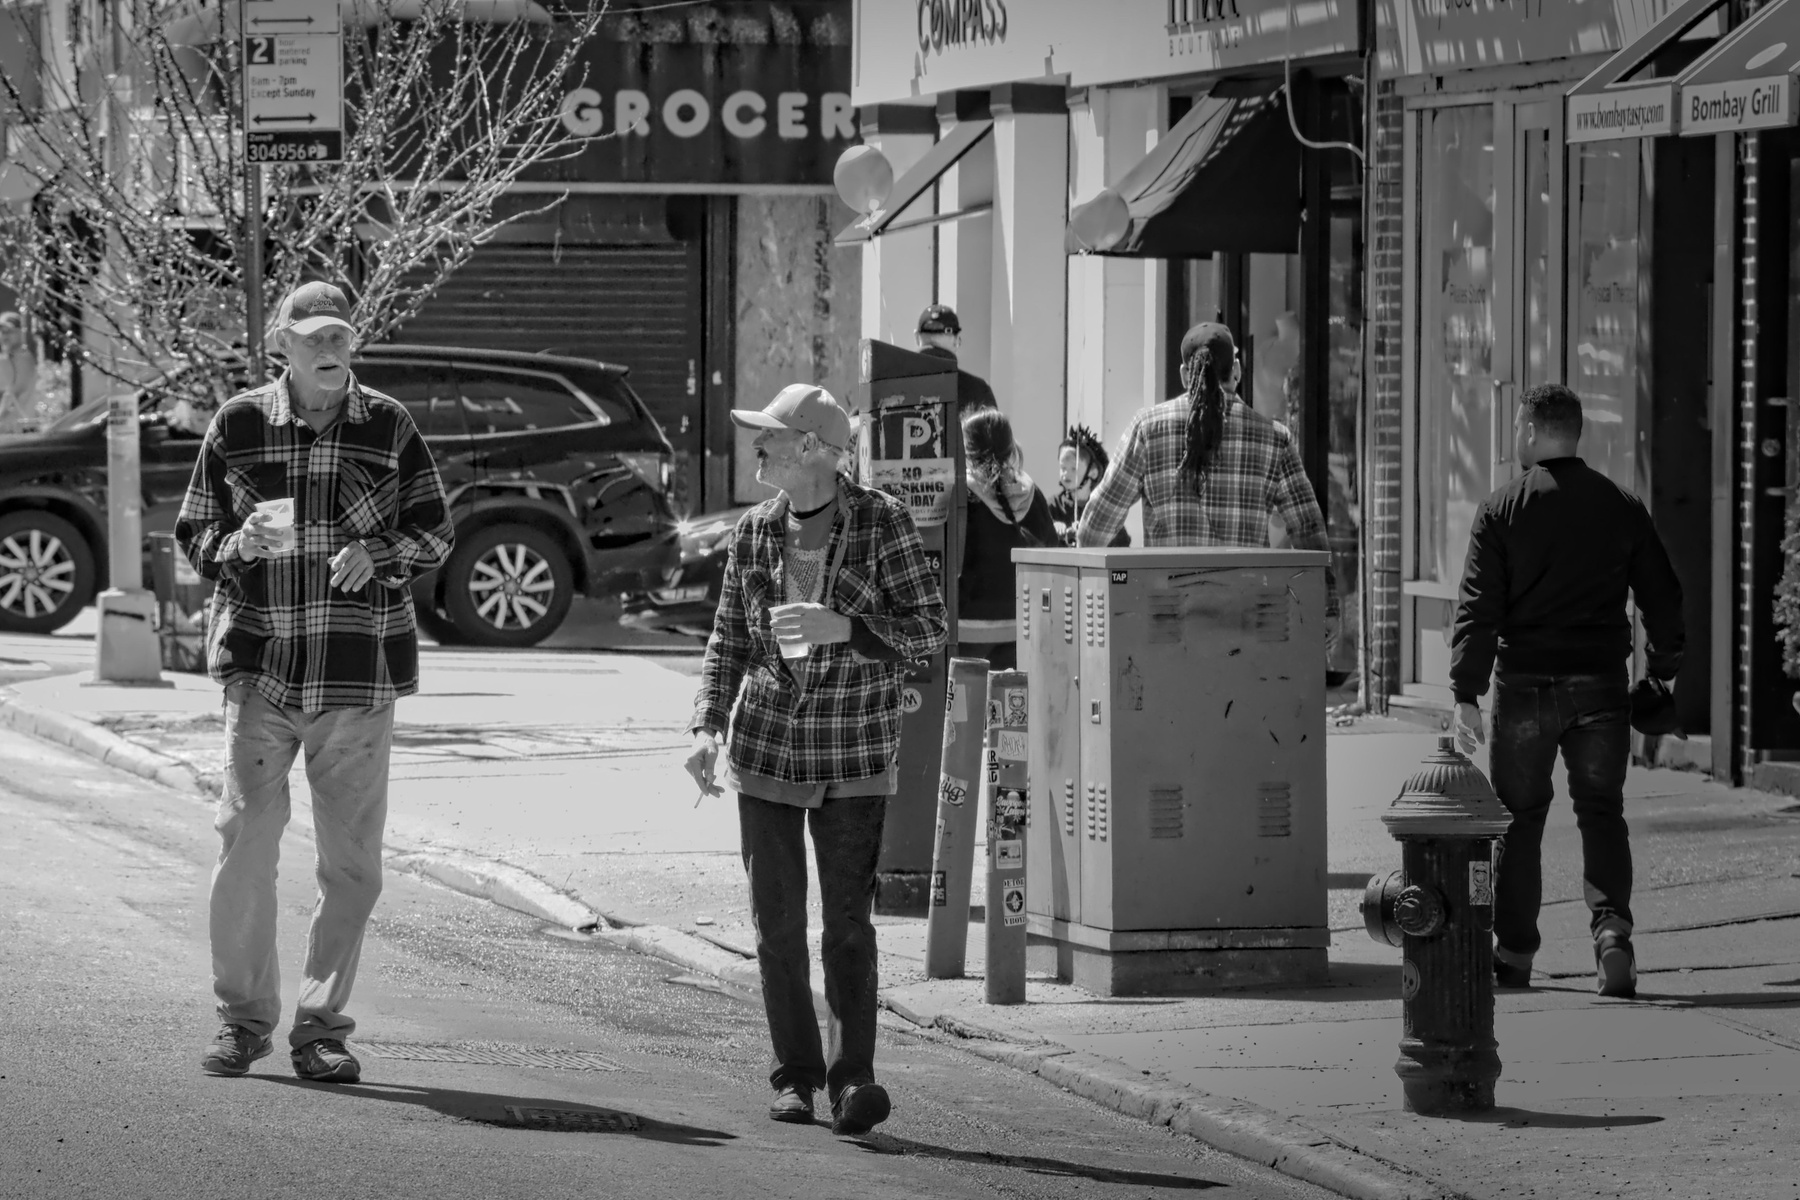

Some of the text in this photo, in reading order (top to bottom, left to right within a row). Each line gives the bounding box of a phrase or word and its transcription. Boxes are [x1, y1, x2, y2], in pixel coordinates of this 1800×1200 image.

[252, 38, 268, 63] 2
[278, 47, 311, 55] metered
[278, 57, 308, 66] parking
[278, 75, 297, 86] 7pm
[251, 87, 316, 99] Except Sunday
[1692, 84, 1780, 124] Bombay Grill
[1576, 100, 1664, 132] www.bombaytasty.com
[248, 143, 307, 161] 304956
[903, 417, 932, 460] P
[902, 467, 922, 481] NO
[1112, 572, 1126, 581] TAP
